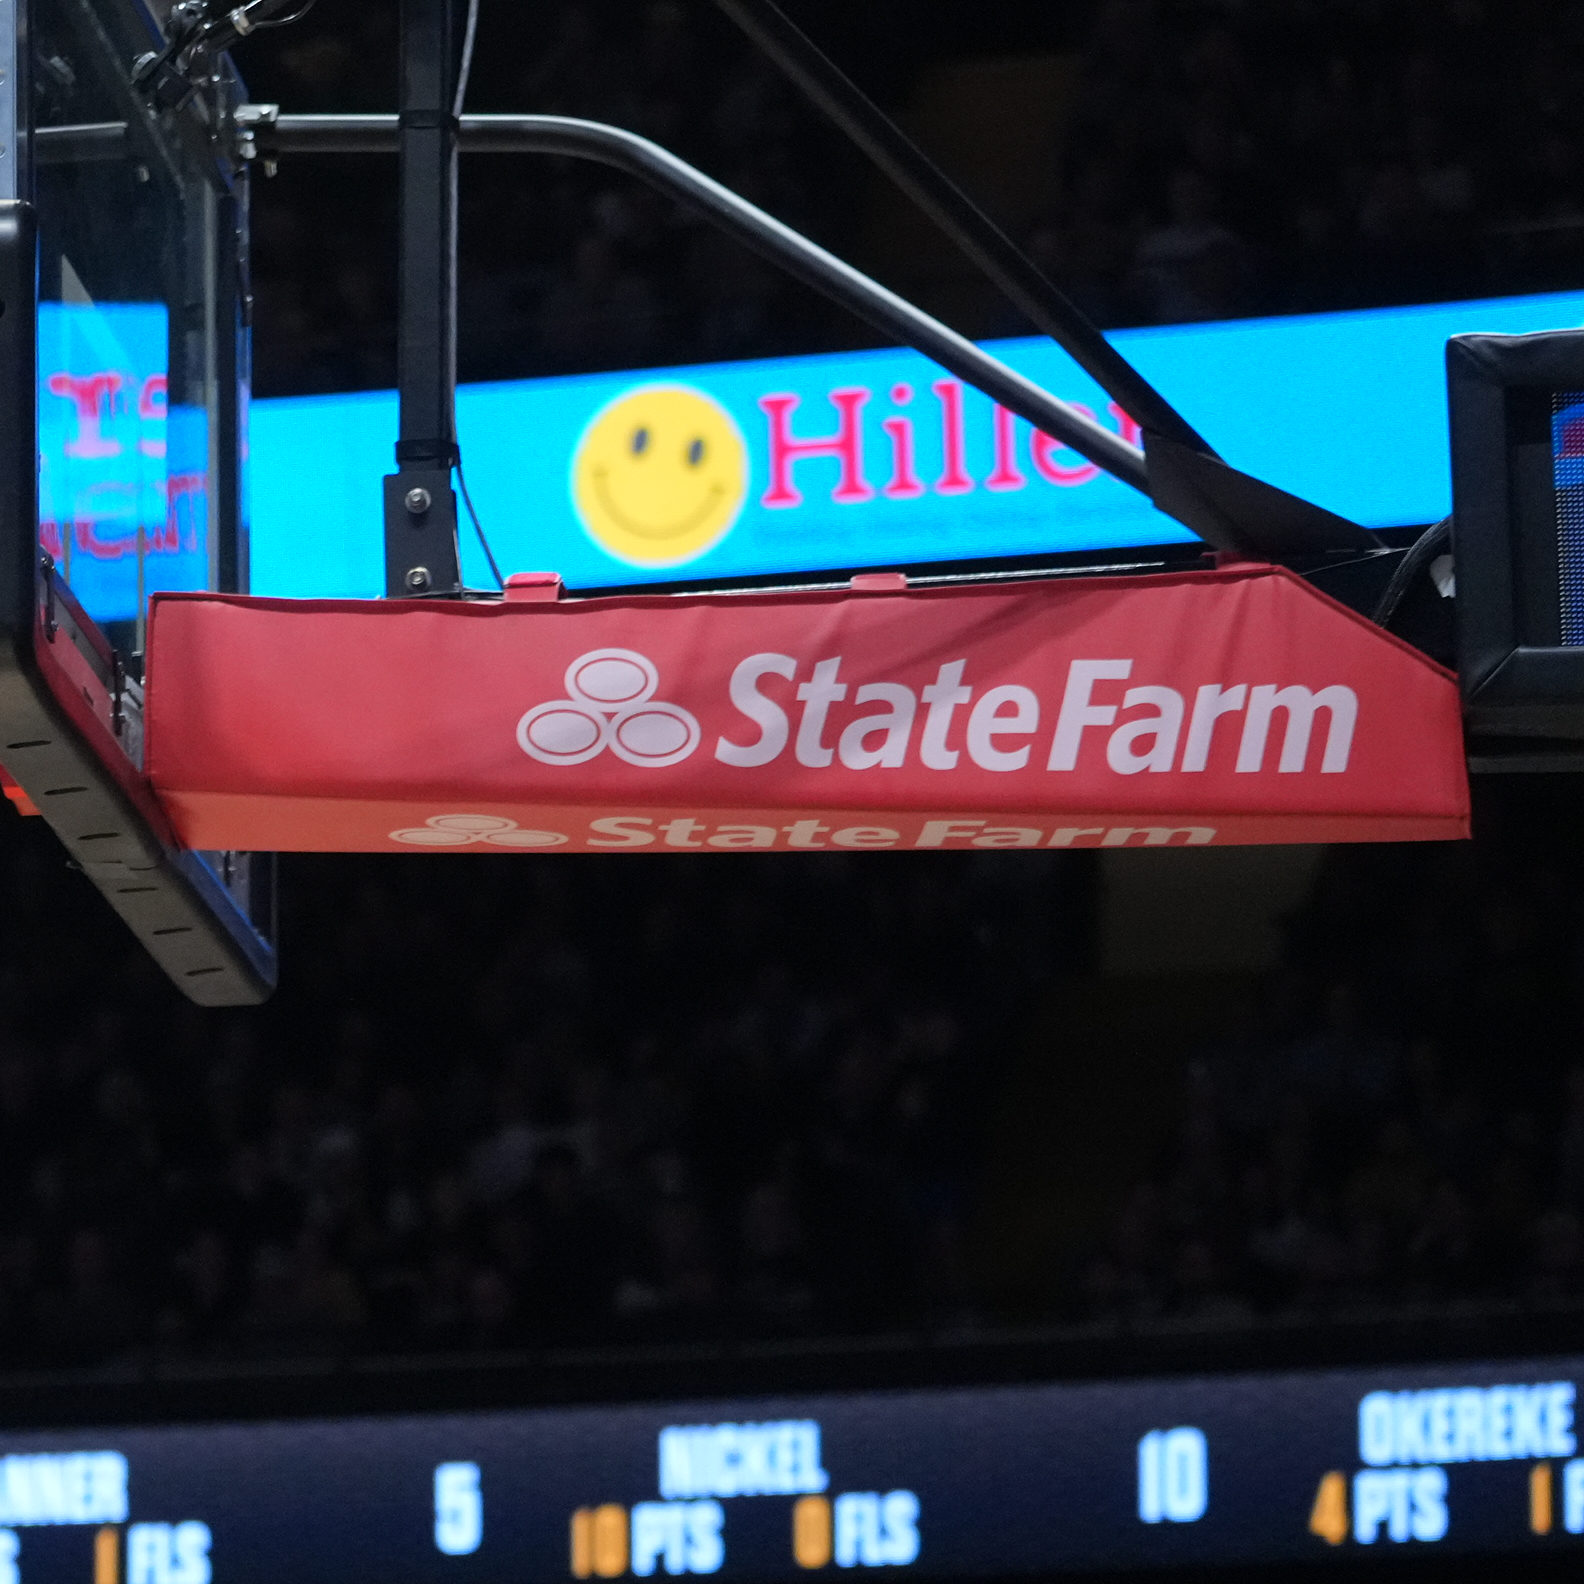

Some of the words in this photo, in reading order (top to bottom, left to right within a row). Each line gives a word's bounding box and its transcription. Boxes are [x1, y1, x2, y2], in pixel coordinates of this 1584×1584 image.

[659, 1418, 830, 1500] NICKEL
[1359, 1381, 1577, 1466] OKEREKE
[434, 1462, 482, 1555] 5
[1138, 1427, 1207, 1524] 10
[1309, 1471, 1348, 1546] 4
[1353, 1466, 1448, 1545] PTS
[1530, 1465, 1552, 1535] 1
[571, 1504, 628, 1578] 10
[632, 1499, 725, 1577] PTS
[794, 1496, 831, 1569] 0
[834, 1489, 919, 1568] FLS
